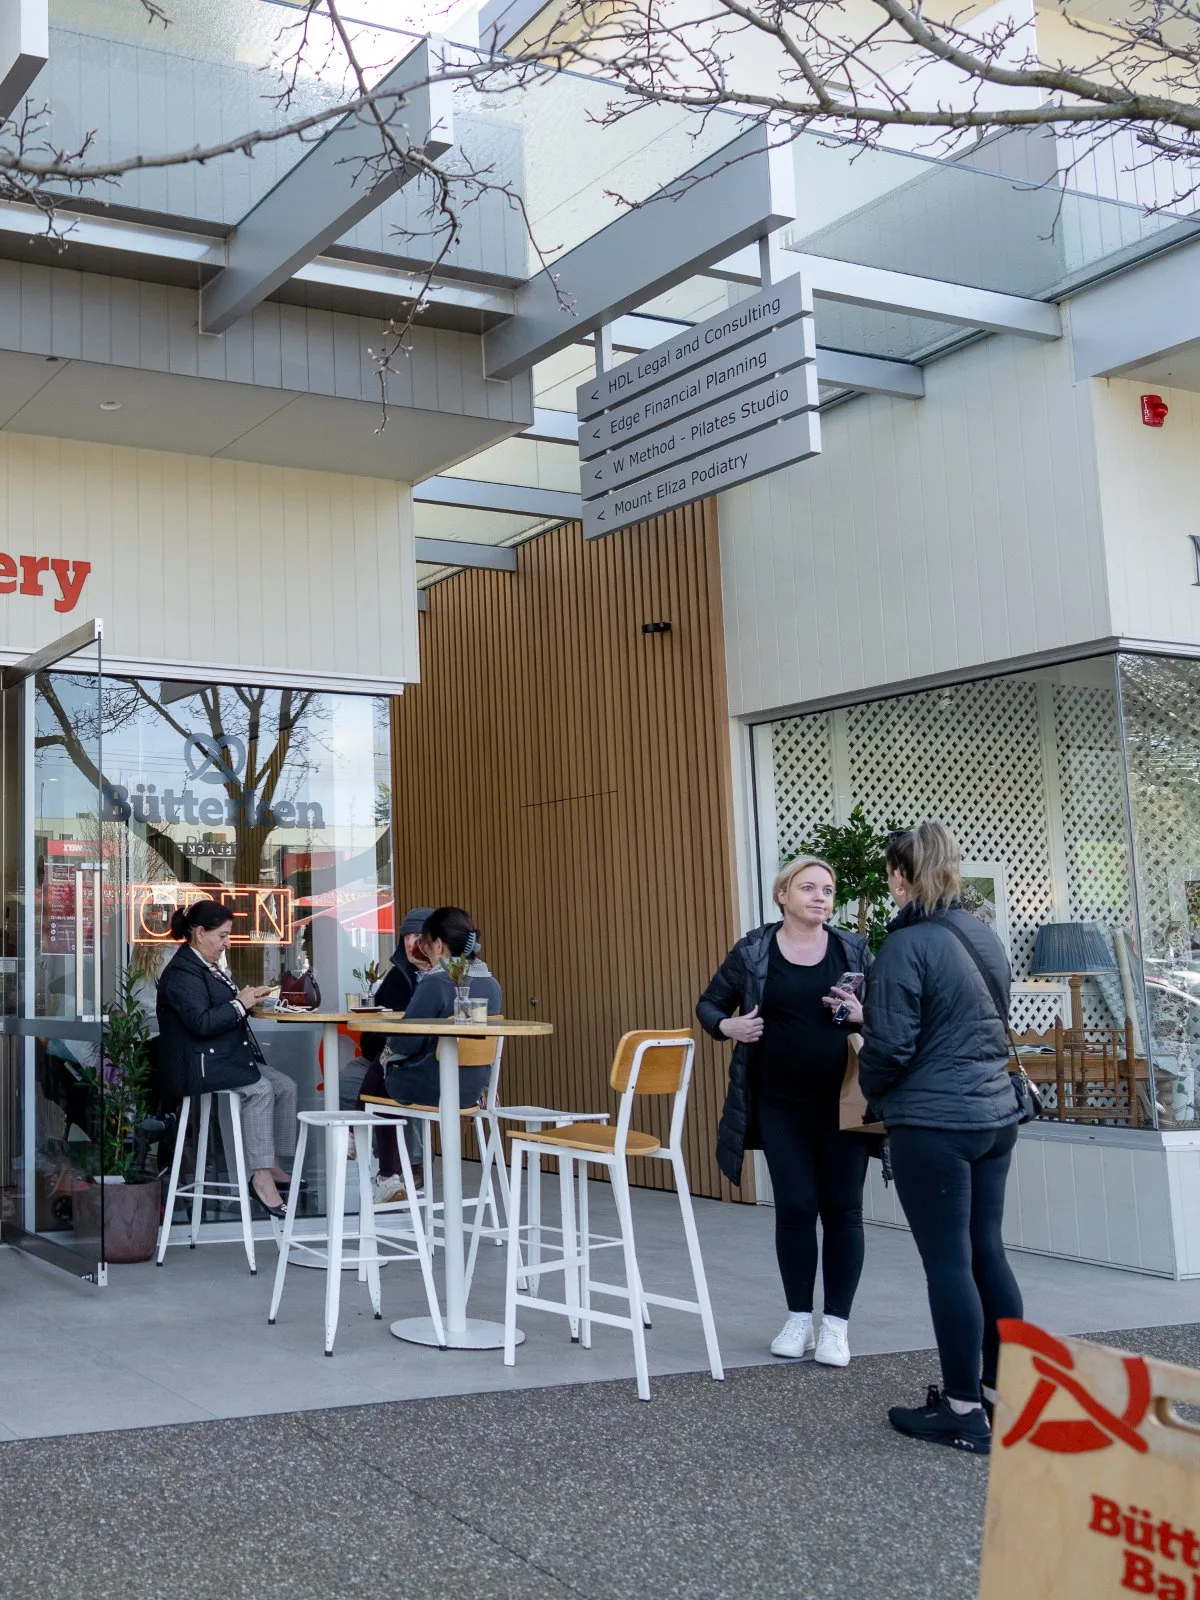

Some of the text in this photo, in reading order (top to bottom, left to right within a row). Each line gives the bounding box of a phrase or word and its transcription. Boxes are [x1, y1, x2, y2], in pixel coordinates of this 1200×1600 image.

[608, 296, 781, 394] HDL Legal and Consulting
[610, 351, 768, 435] Edge Financial Planning
[613, 460, 625, 474] W
[629, 435, 676, 465] Method
[691, 413, 736, 441] Pilates
[741, 388, 790, 419] Studio
[614, 451, 749, 516] Mount Eliza Podiatry
[101, 783, 326, 830] Bütterken
[1088, 1493, 1200, 1570] Bütt
[1121, 1549, 1200, 1600] Ba
